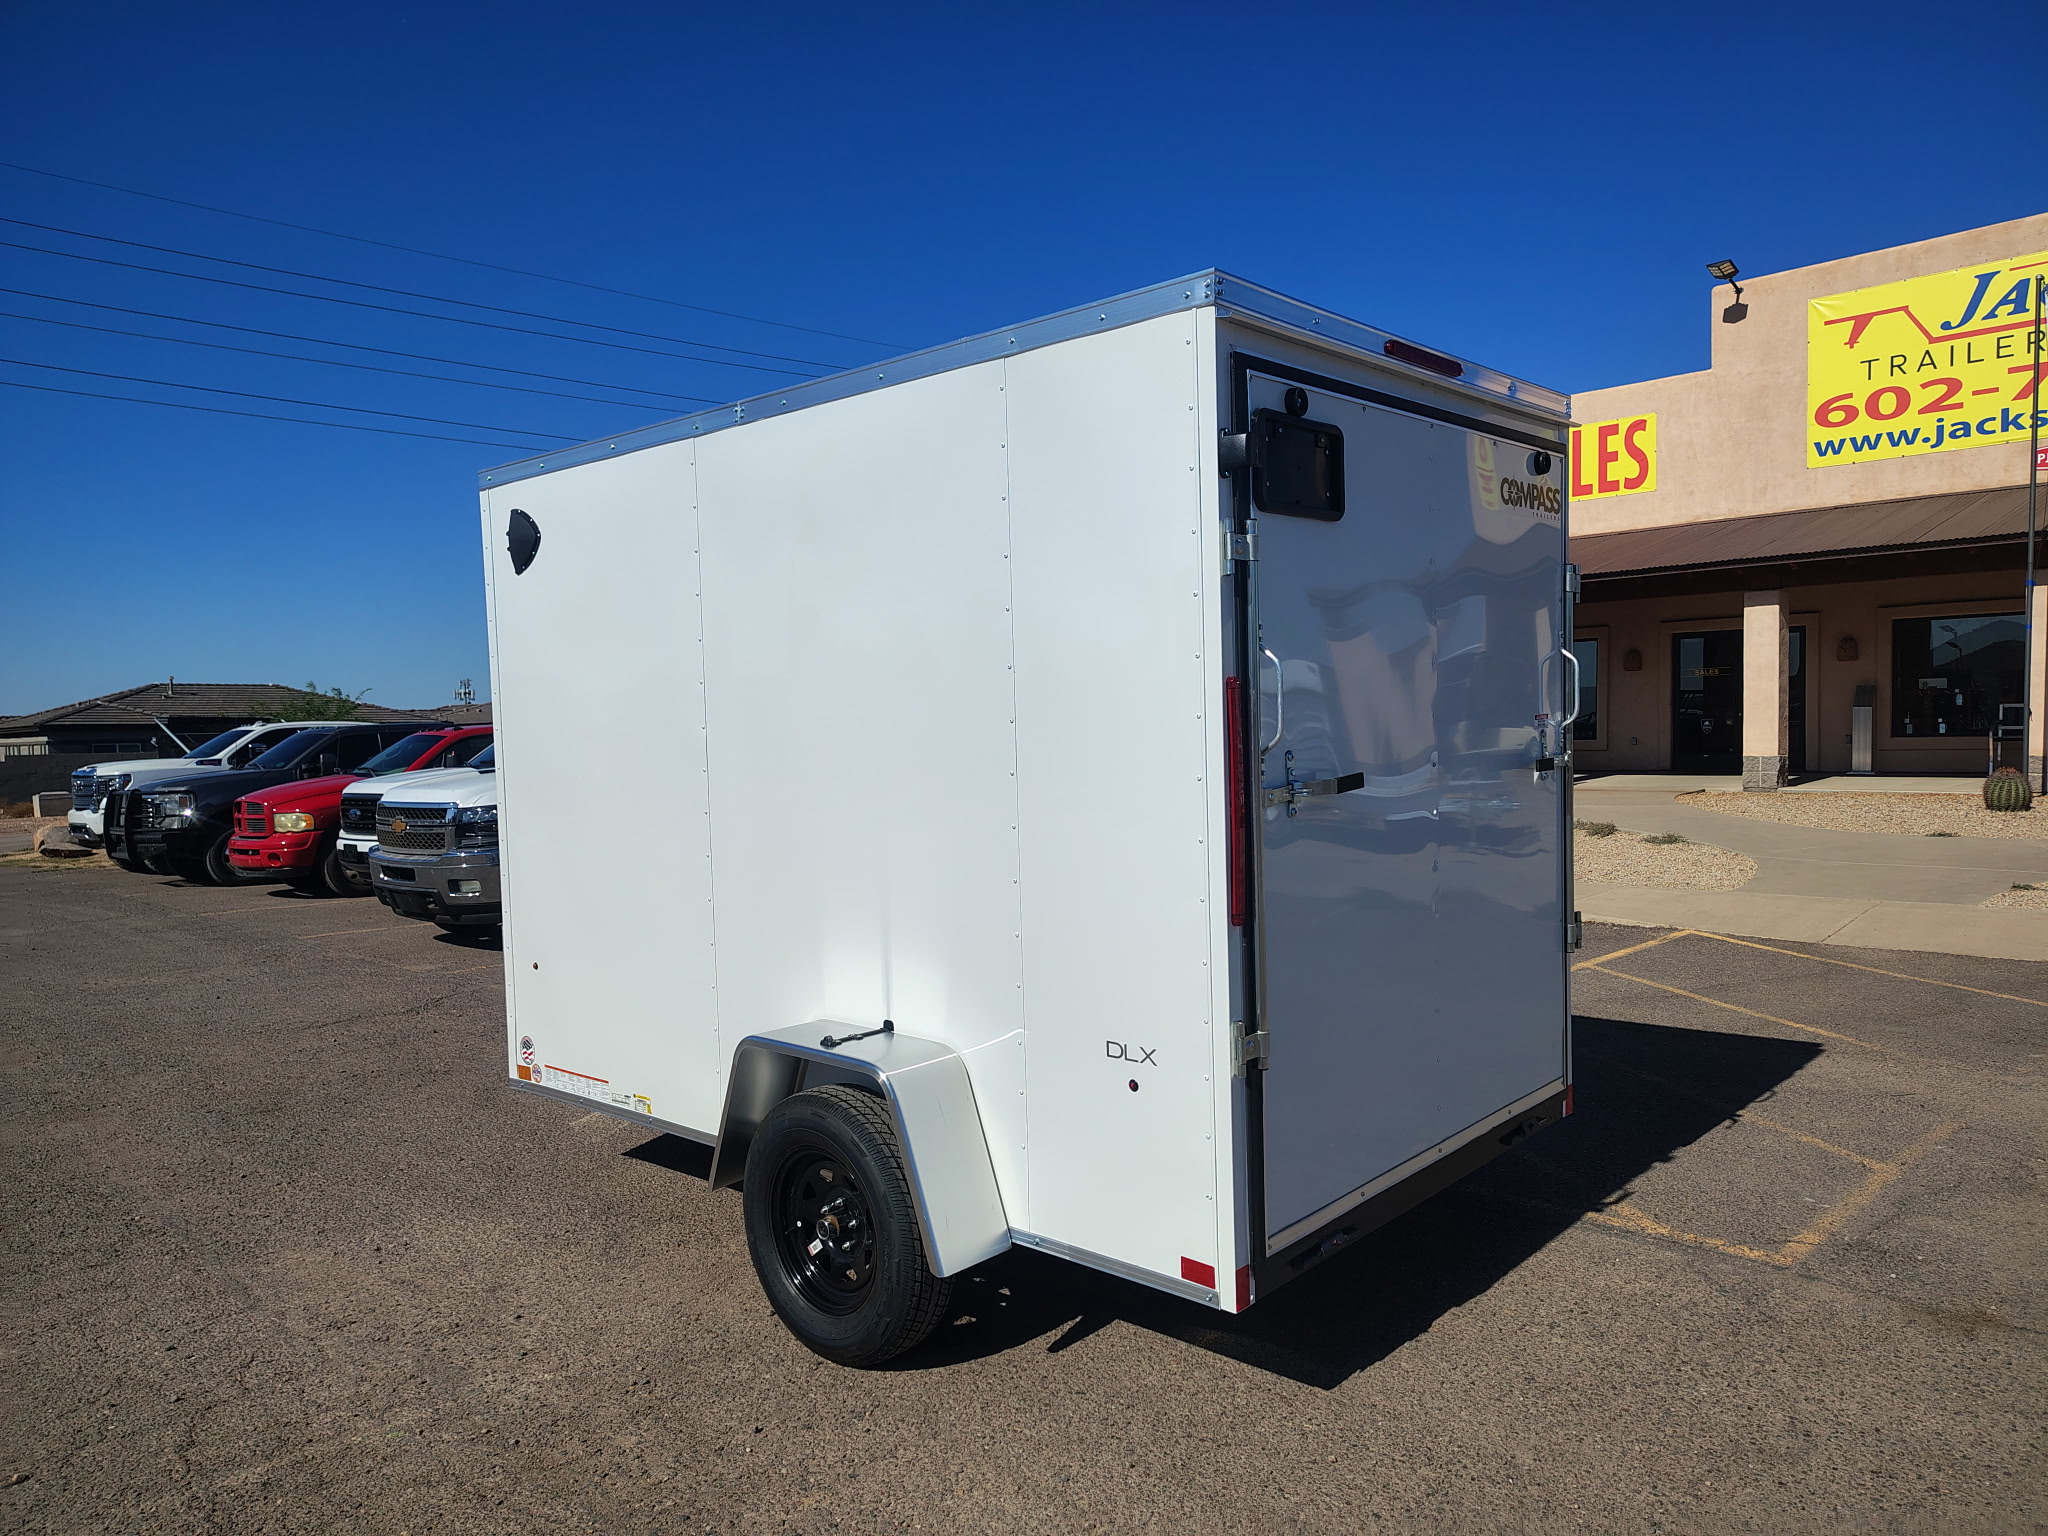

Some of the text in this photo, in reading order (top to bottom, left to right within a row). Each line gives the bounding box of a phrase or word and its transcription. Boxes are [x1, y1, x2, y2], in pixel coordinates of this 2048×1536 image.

[1940, 270, 2048, 331] JA
[1860, 330, 2046, 381] TRAILER
[1814, 361, 2048, 428] 602-7
[1572, 418, 1649, 497] LES
[1501, 476, 1561, 514] COMPASS
[1695, 668, 1719, 676] SALES
[1106, 1040, 1157, 1066] DLX
